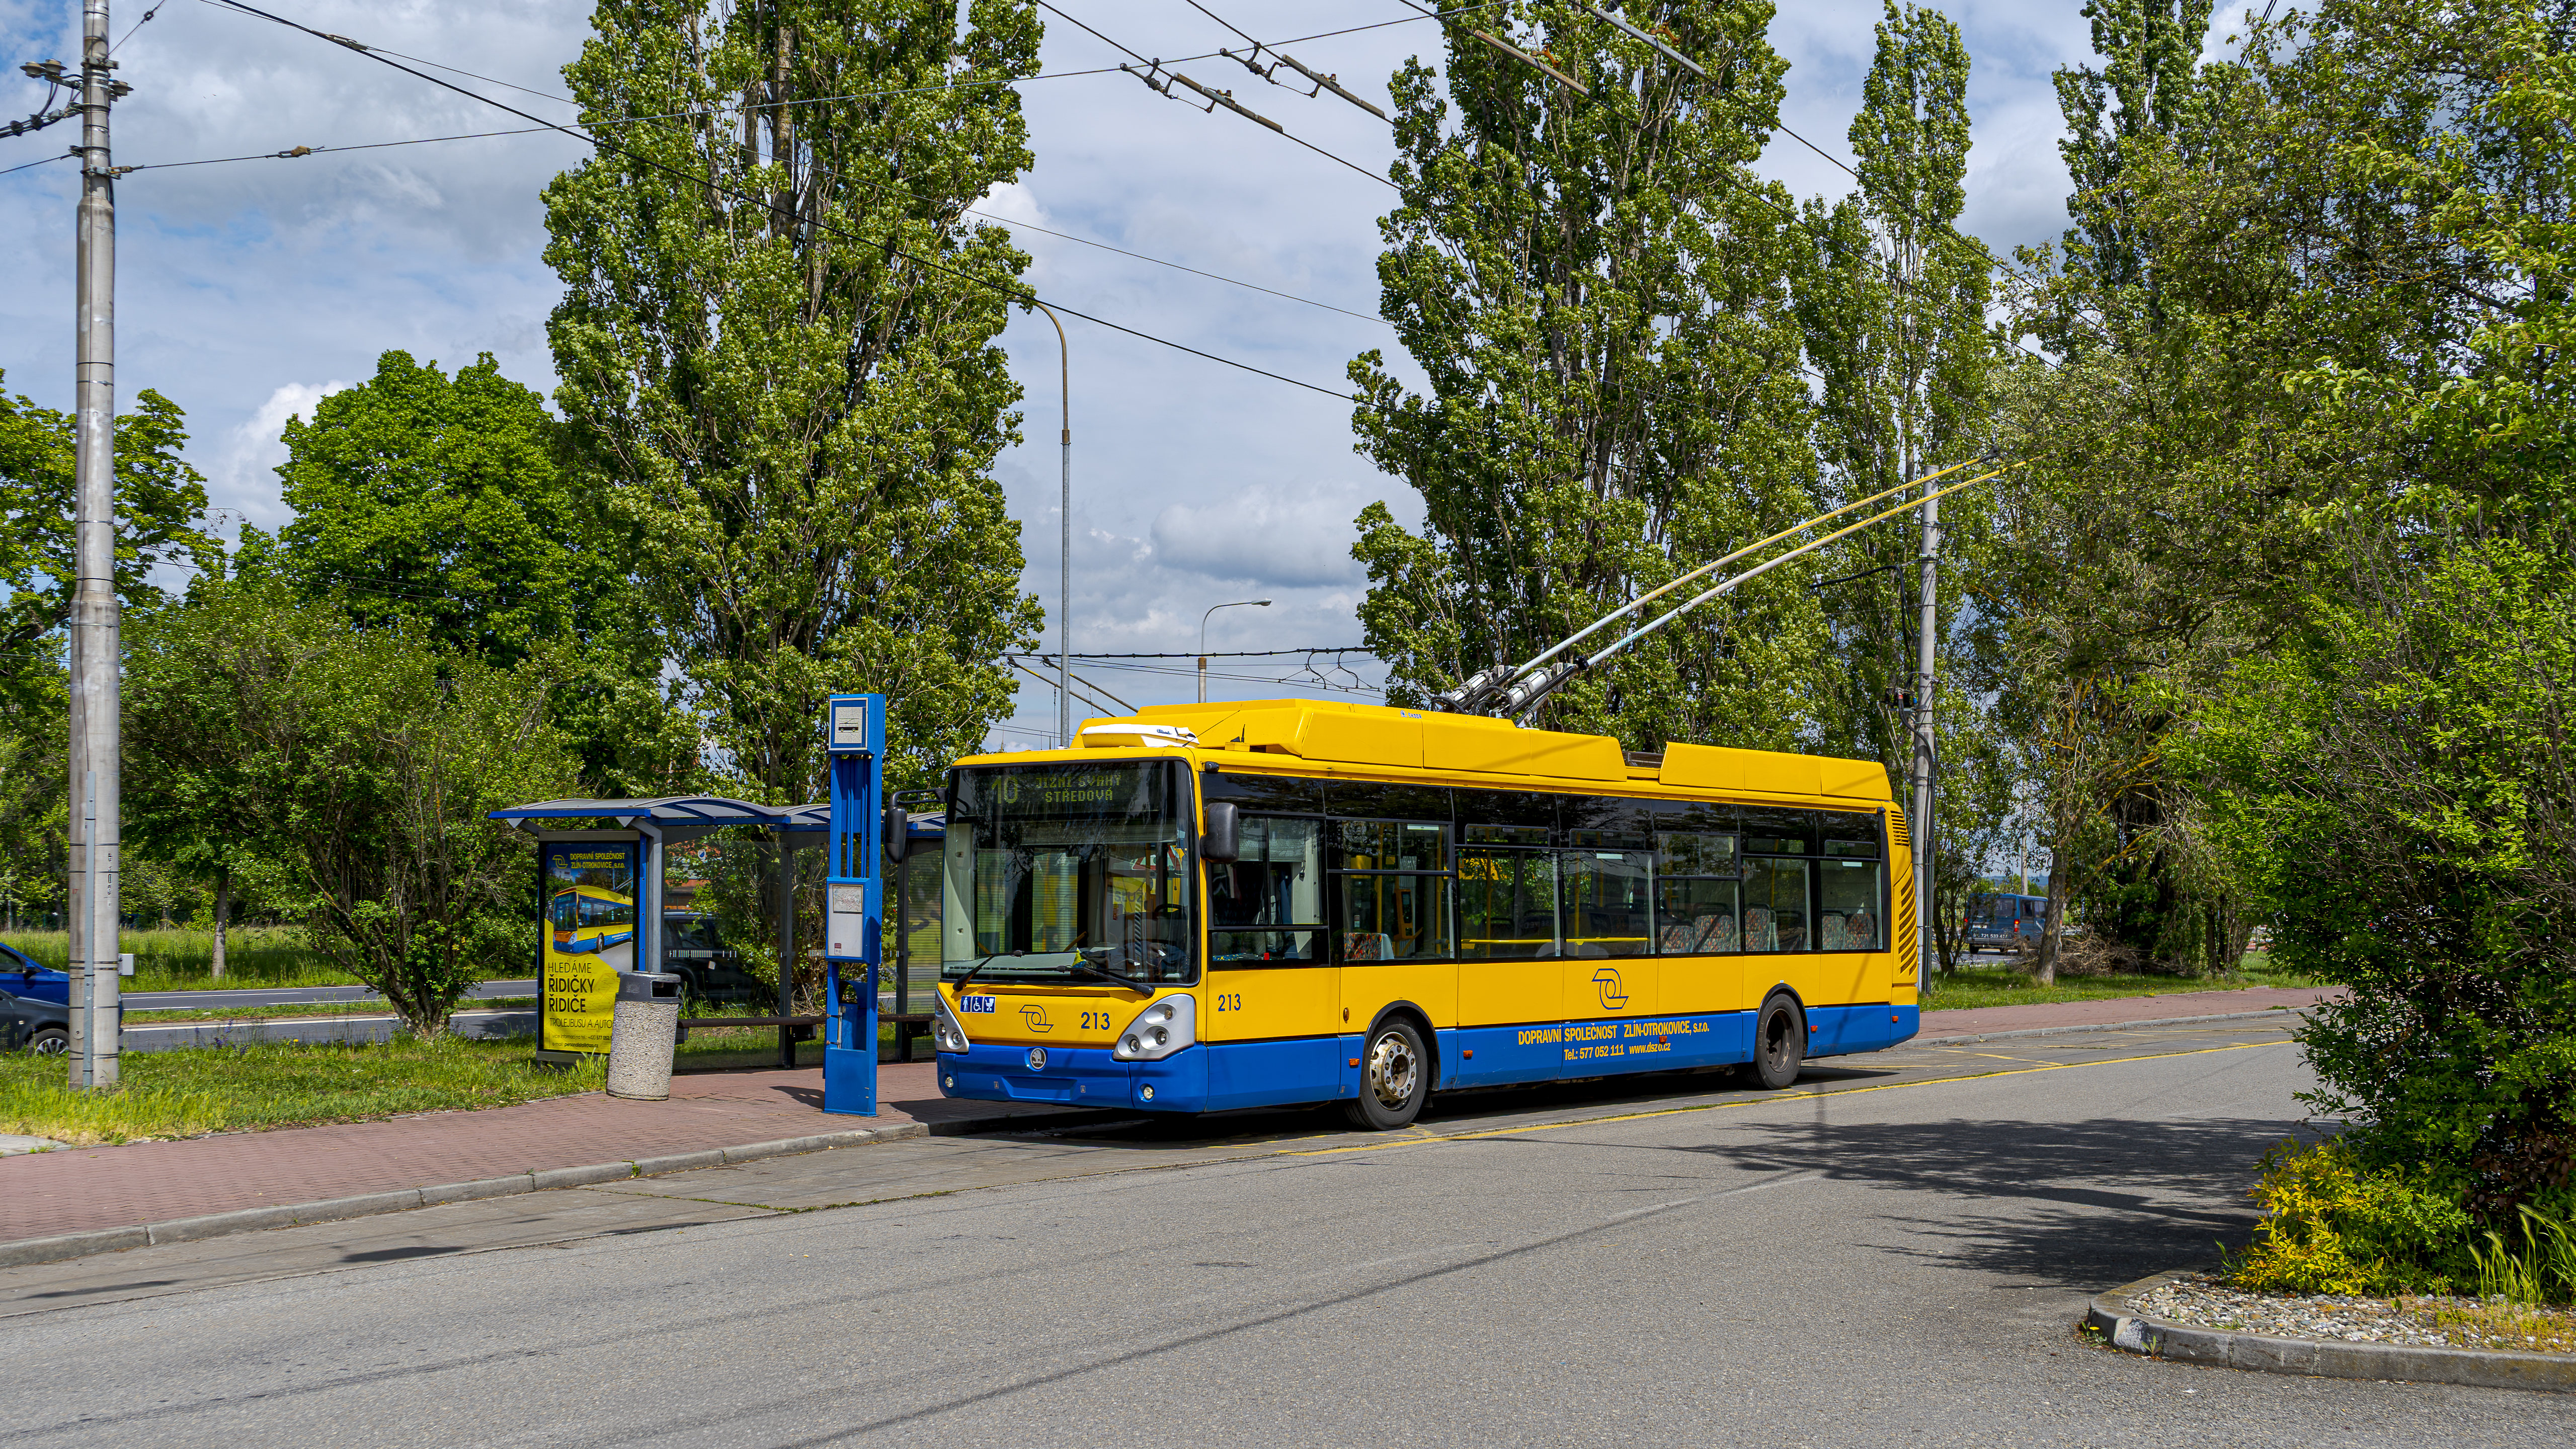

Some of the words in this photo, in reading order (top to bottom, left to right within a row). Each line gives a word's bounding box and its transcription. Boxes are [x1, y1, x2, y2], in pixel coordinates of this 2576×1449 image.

[991, 775, 1018, 803] 10
[1045, 787, 1113, 802] STŘEDOVÁ
[570, 851, 595, 860] DOPRAVNÍ
[595, 851, 625, 859] SPOLEČNOST
[548, 960, 591, 973] HLEDÁME
[548, 974, 595, 993] ŘIDIČKY
[548, 994, 587, 1013] ŘIDIČE
[1218, 994, 1241, 1012] 213
[549, 1017, 586, 1027] TROLEJBUSŮ
[587, 1019, 593, 1027] A
[1081, 1011, 1110, 1030] 213
[1518, 1025, 1562, 1045] DOPRAVNÍ
[1564, 1023, 1618, 1042] SPOLEČNOST
[1624, 1020, 1692, 1038] ZLÍN-OTROKOVICE,
[1693, 1022, 1710, 1033] s.r.o.
[1564, 1048, 1578, 1061] Tel.:
[1580, 1046, 1593, 1059] 577
[1595, 1045, 1608, 1058] 052
[1610, 1044, 1625, 1056] 111
[1629, 1041, 1671, 1055] www.dszo.cz
